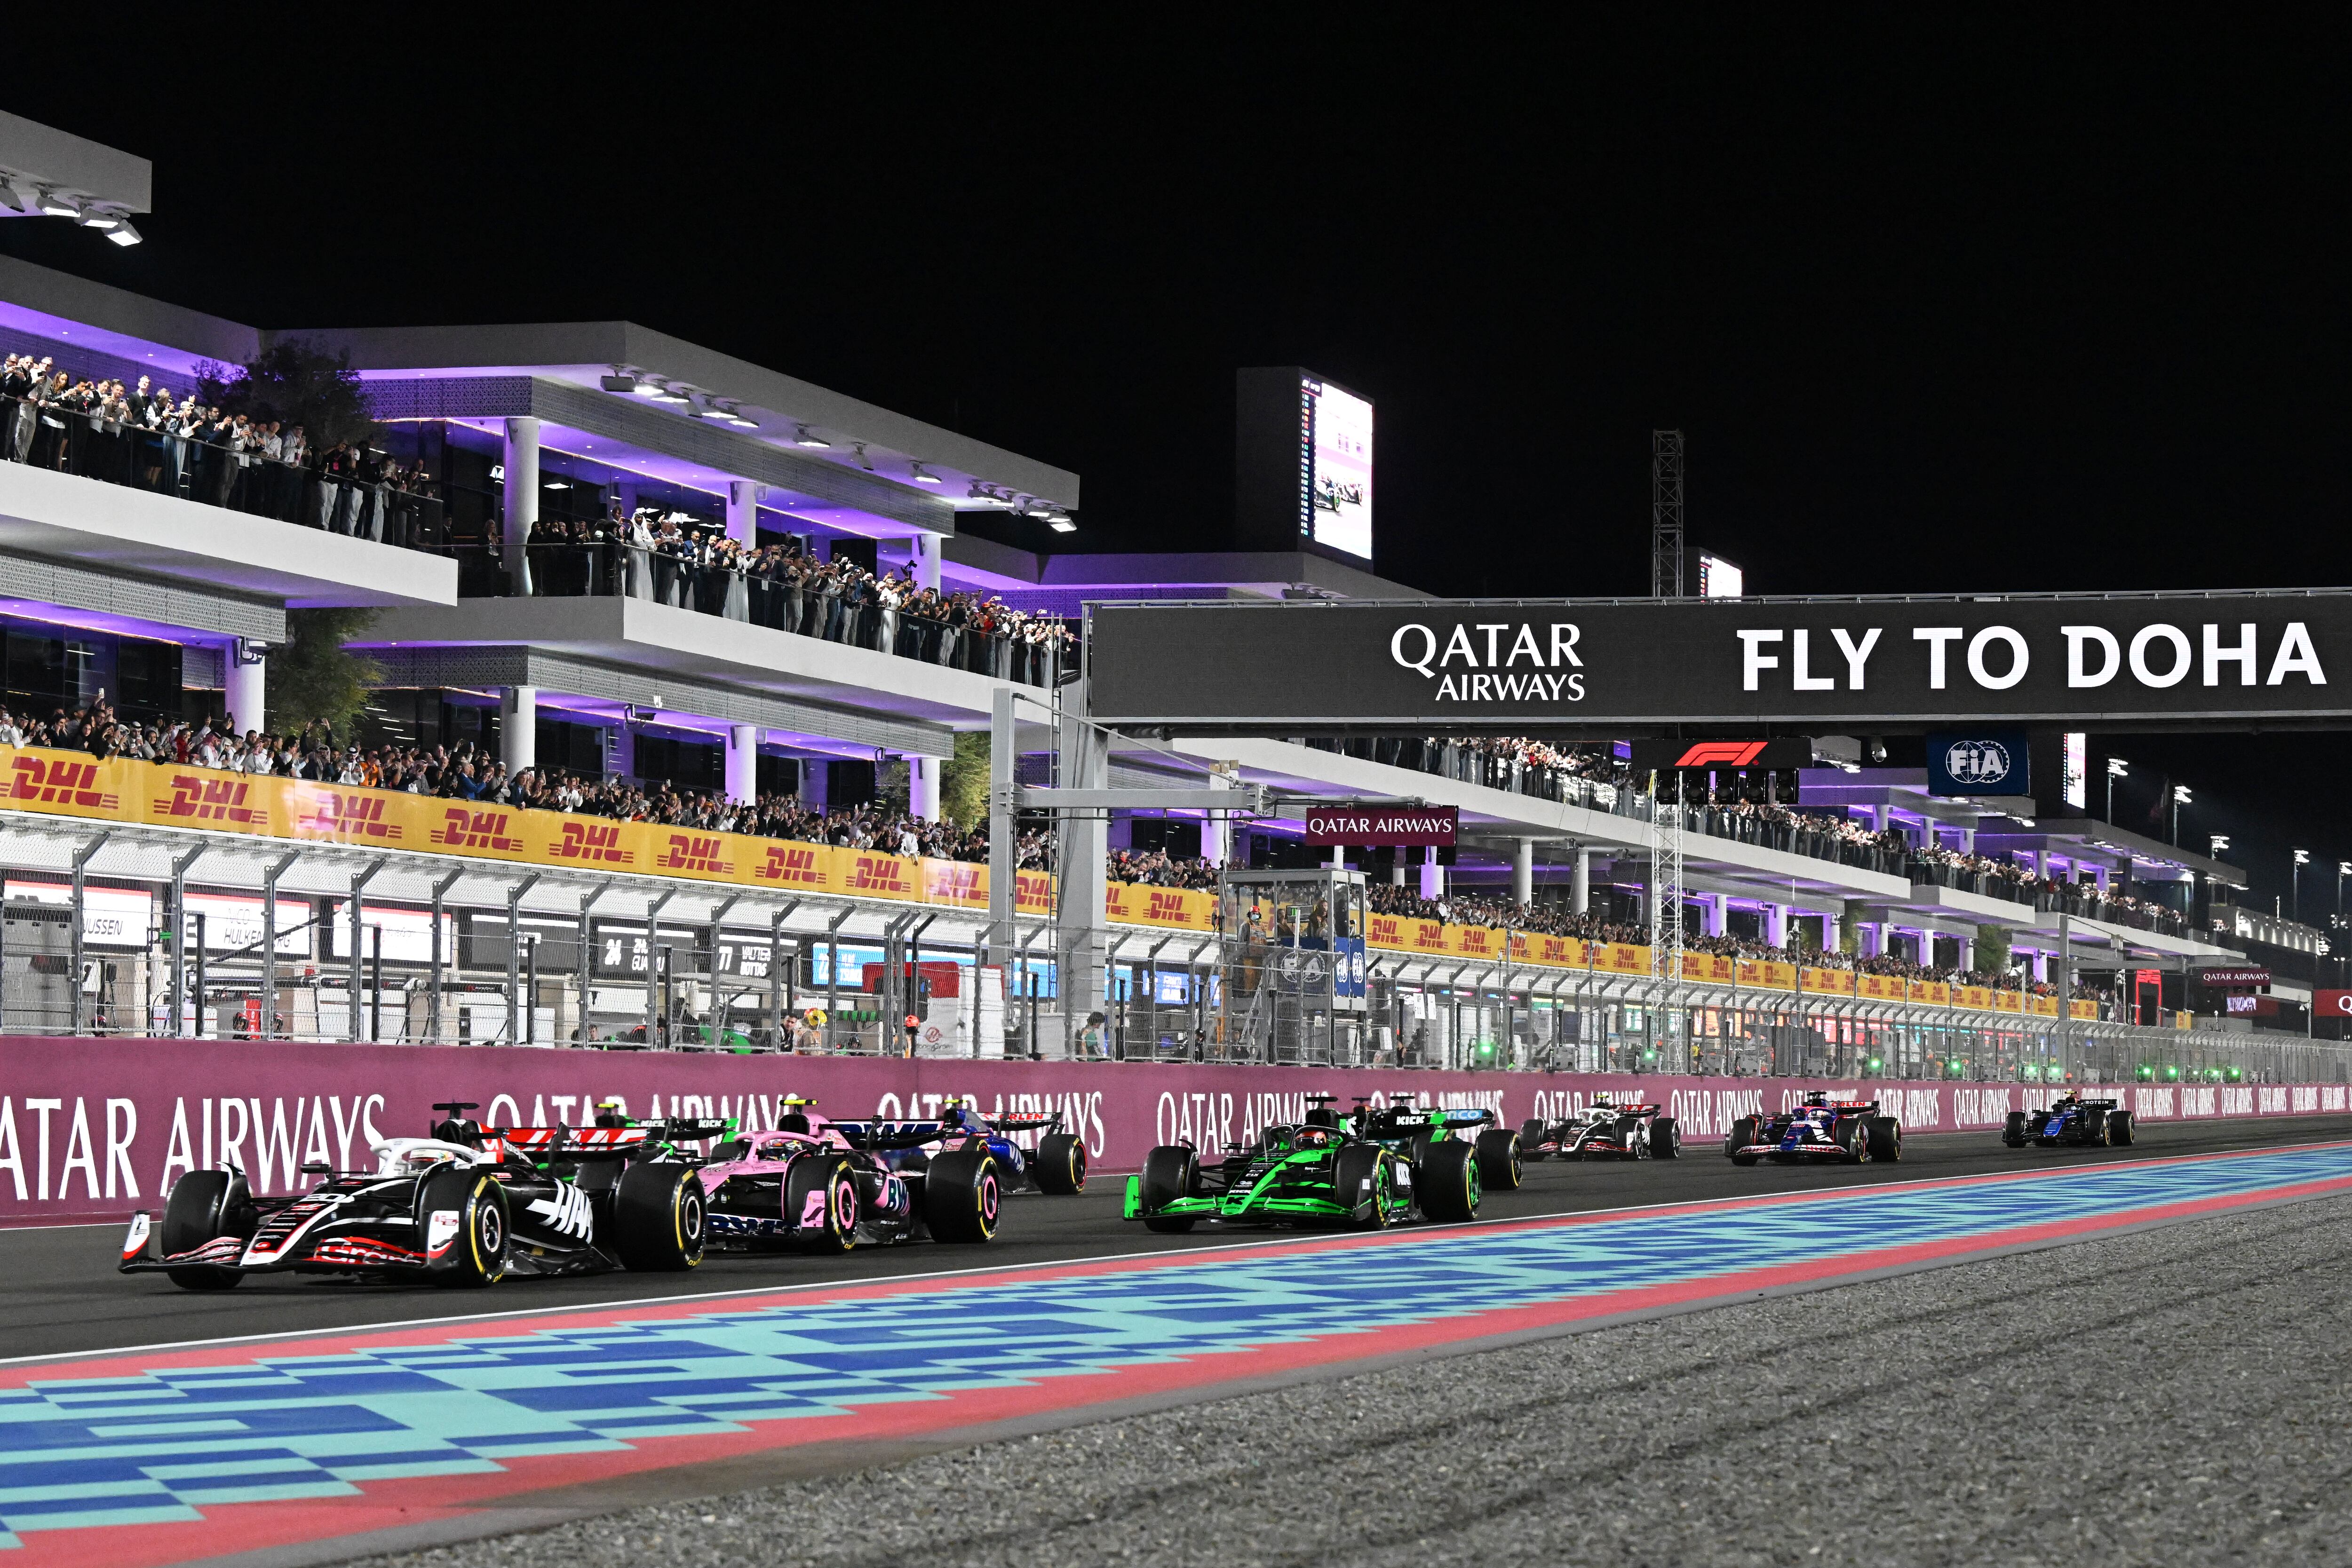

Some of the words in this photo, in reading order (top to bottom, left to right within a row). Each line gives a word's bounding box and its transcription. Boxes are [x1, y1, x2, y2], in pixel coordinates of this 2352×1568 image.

[1391, 623, 1584, 678] QATAR
[1737, 628, 1883, 691] FLY
[1913, 626, 2029, 689] TO
[2061, 622, 2327, 688] DOHA
[1435, 673, 1585, 701] AIRWAYS
[1674, 741, 1769, 767] F1
[9, 756, 103, 808] DHL
[169, 775, 253, 823] DHL
[312, 793, 389, 839] DHL
[444, 808, 512, 852] DHL
[1310, 818, 1370, 836] QATAR
[1375, 818, 1452, 832] AIRWAYS
[561, 822, 623, 863] DHL
[667, 834, 724, 873] DHL
[765, 847, 819, 884] DHL
[855, 857, 903, 892] DHL
[936, 866, 982, 900] DHL
[1149, 892, 1185, 922] DHL
[83, 918, 123, 935] USSEN
[224, 928, 290, 948] HULKENRG
[1372, 919, 1398, 944] DHL
[1419, 924, 1443, 949] DHL
[1463, 930, 1487, 954] DHL
[604, 939, 621, 966] 24
[632, 955, 665, 972] GUAU
[1284, 958, 1321, 976] FA
[740, 961, 767, 976] BOTTAS
[2203, 973, 2232, 982] QATAR
[1670, 1089, 1711, 1135] QATAR
[1714, 1089, 1763, 1134] AIRWAYS
[1905, 1088, 1939, 1127] AIRWAYS
[1954, 1088, 1979, 1129] QATAR
[1980, 1088, 2011, 1125] AIRWAYS
[2136, 1088, 2153, 1120] QATAR
[2153, 1088, 2173, 1117] AIRWAYS
[2181, 1087, 2197, 1118] QATAR
[2197, 1087, 2215, 1115] AIRWAYS
[698, 1119, 723, 1128] KICK
[1157, 1092, 1233, 1155] QATAR
[1241, 1091, 1329, 1154] AIRWA
[1396, 1116, 1425, 1125] KICK
[160, 1094, 384, 1198] AIRWAYS
[1395, 1162, 1412, 1186] KIC
